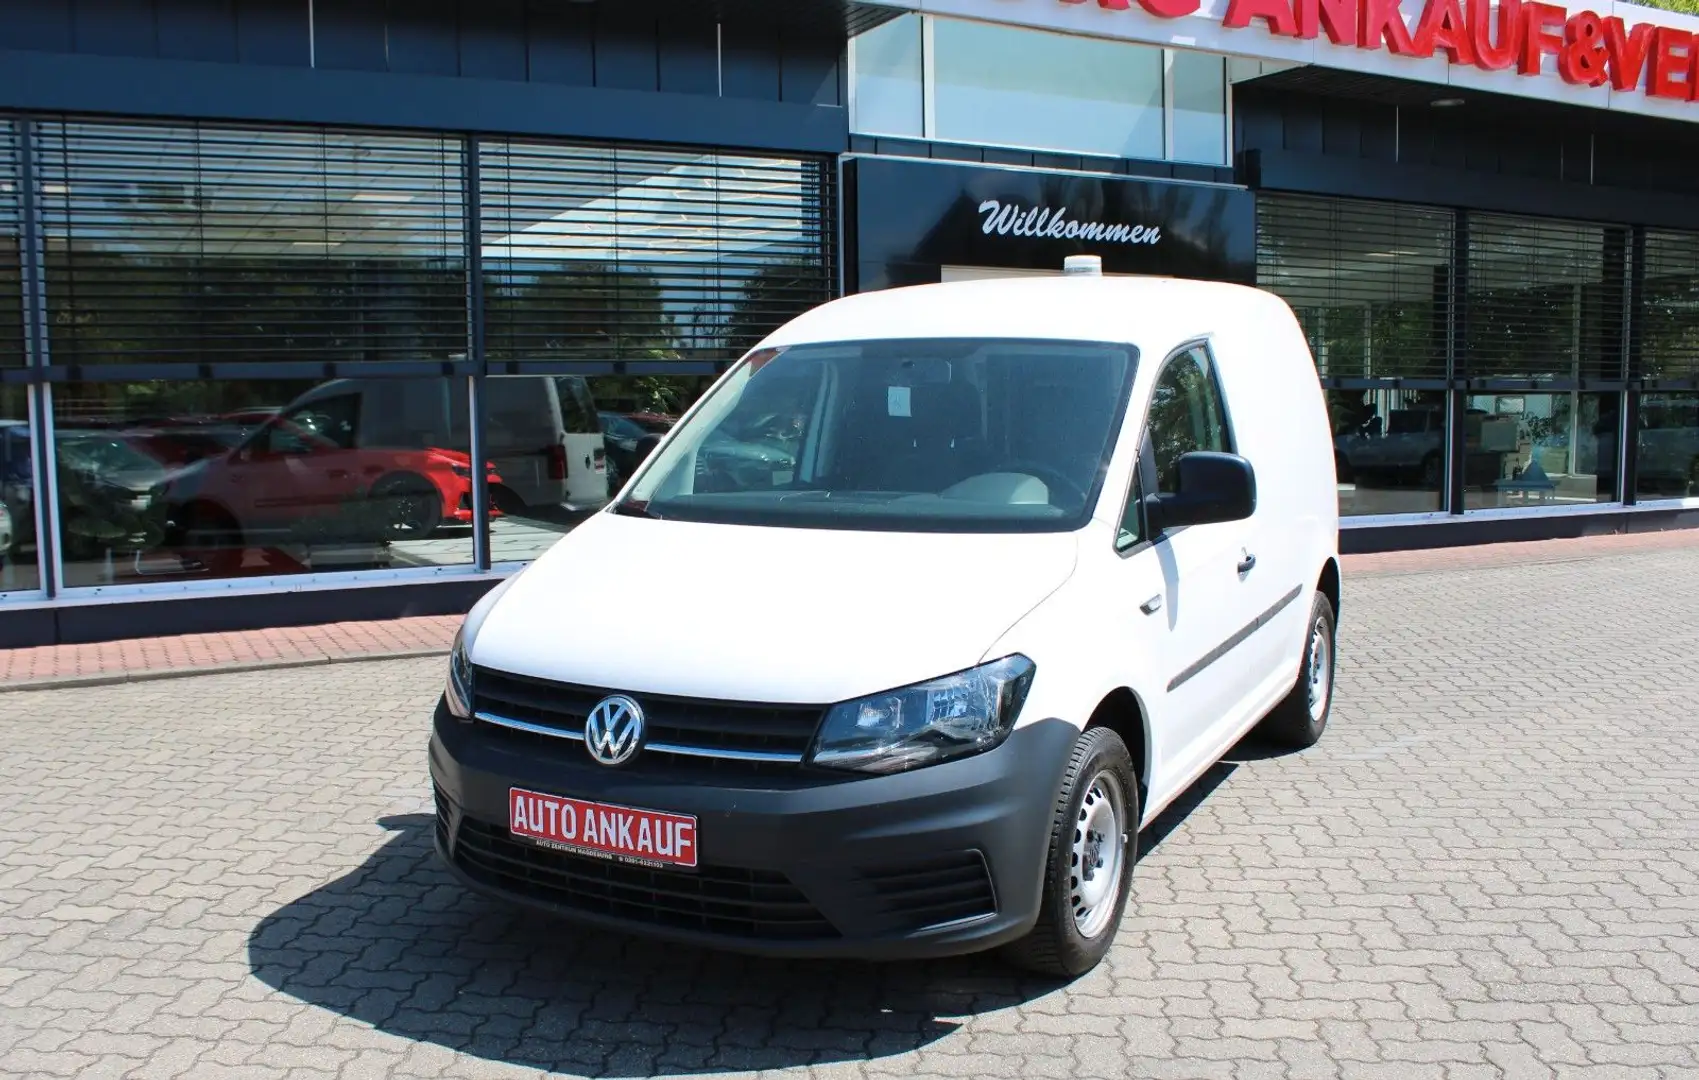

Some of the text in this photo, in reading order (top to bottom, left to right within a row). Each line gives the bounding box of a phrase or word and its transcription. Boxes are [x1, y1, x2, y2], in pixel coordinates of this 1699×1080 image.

[1222, 0, 1699, 102] ANKAUF&VE
[978, 200, 1161, 244] Willkommen
[514, 795, 693, 858] AUTO ANKAUF
